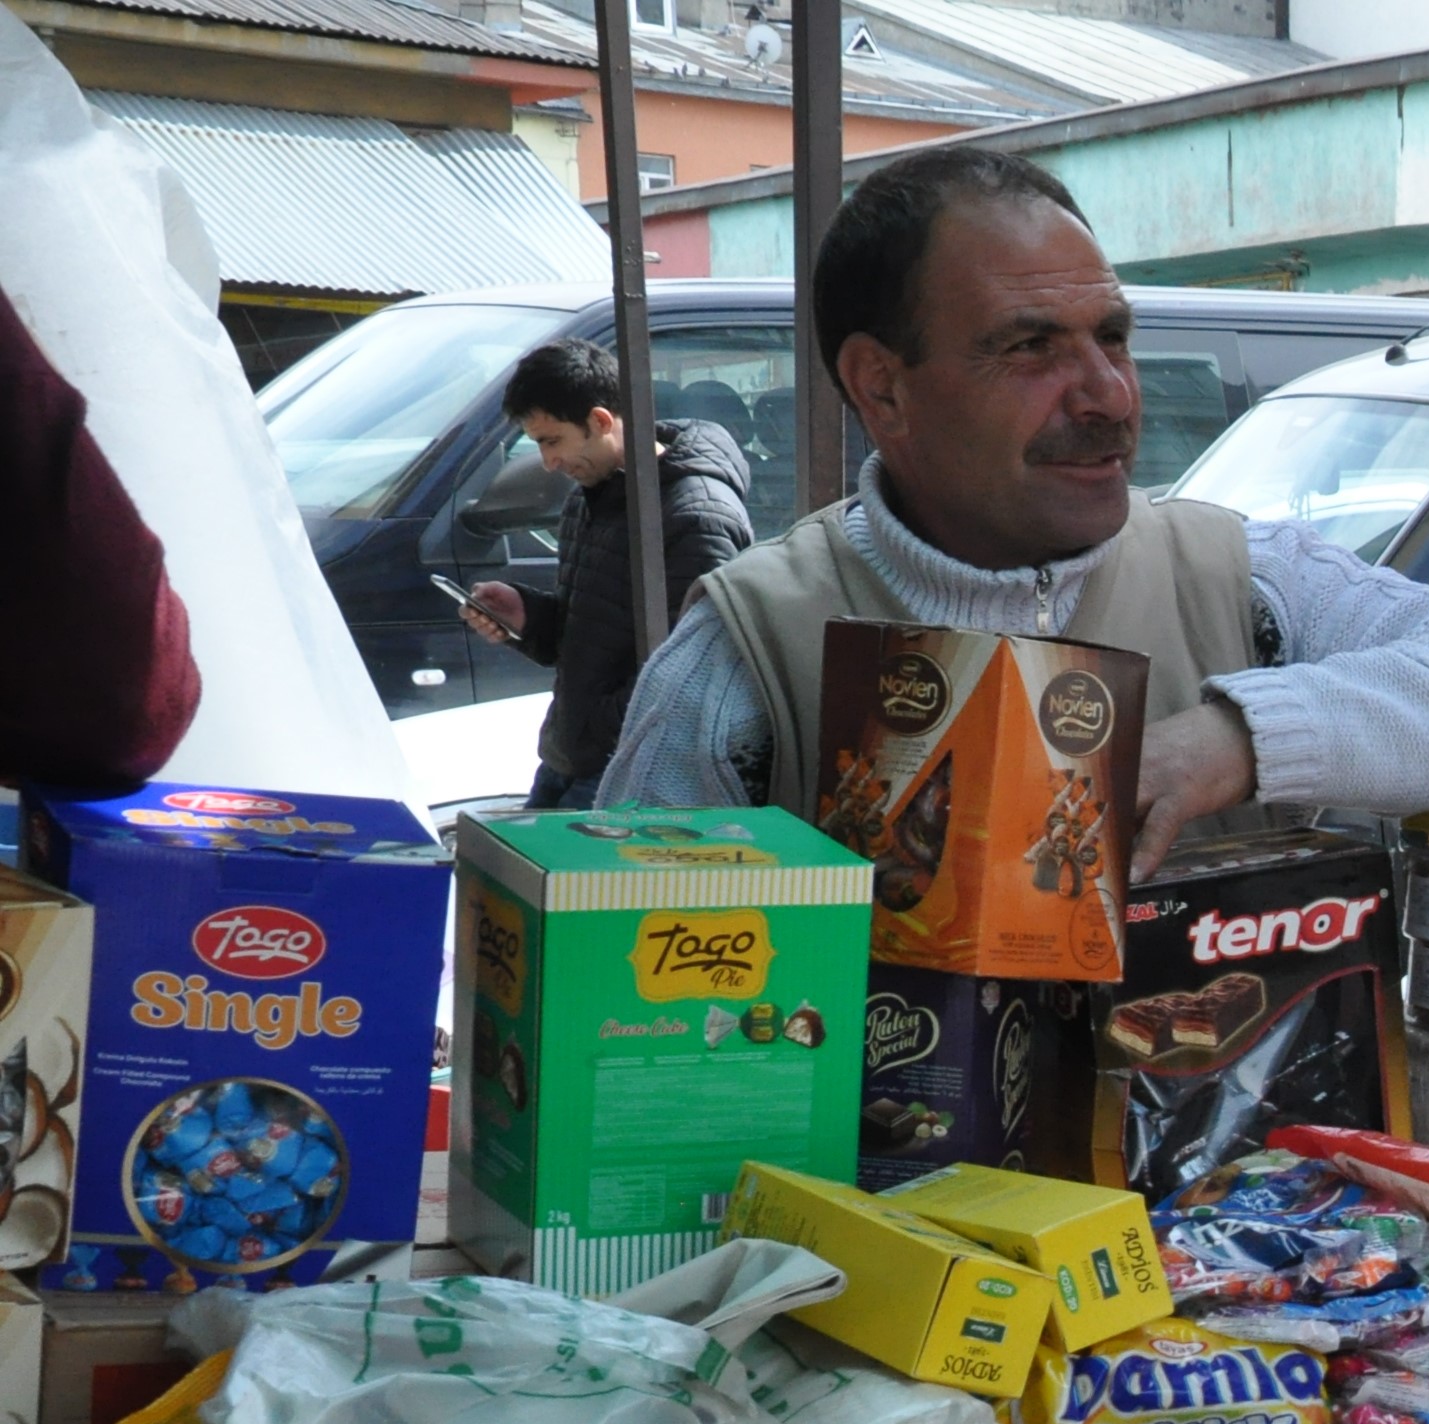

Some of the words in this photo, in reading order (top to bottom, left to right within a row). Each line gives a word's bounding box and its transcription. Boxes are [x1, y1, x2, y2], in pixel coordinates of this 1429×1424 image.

[878, 674, 938, 700] Novien
[1049, 696, 1103, 720] Novien
[208, 916, 312, 964] Togo
[647, 923, 756, 976] Togo
[1188, 896, 1380, 964] tenor
[710, 967, 746, 990] Pie
[131, 971, 363, 1050] Single
[1059, 1347, 1324, 1424] Damla
